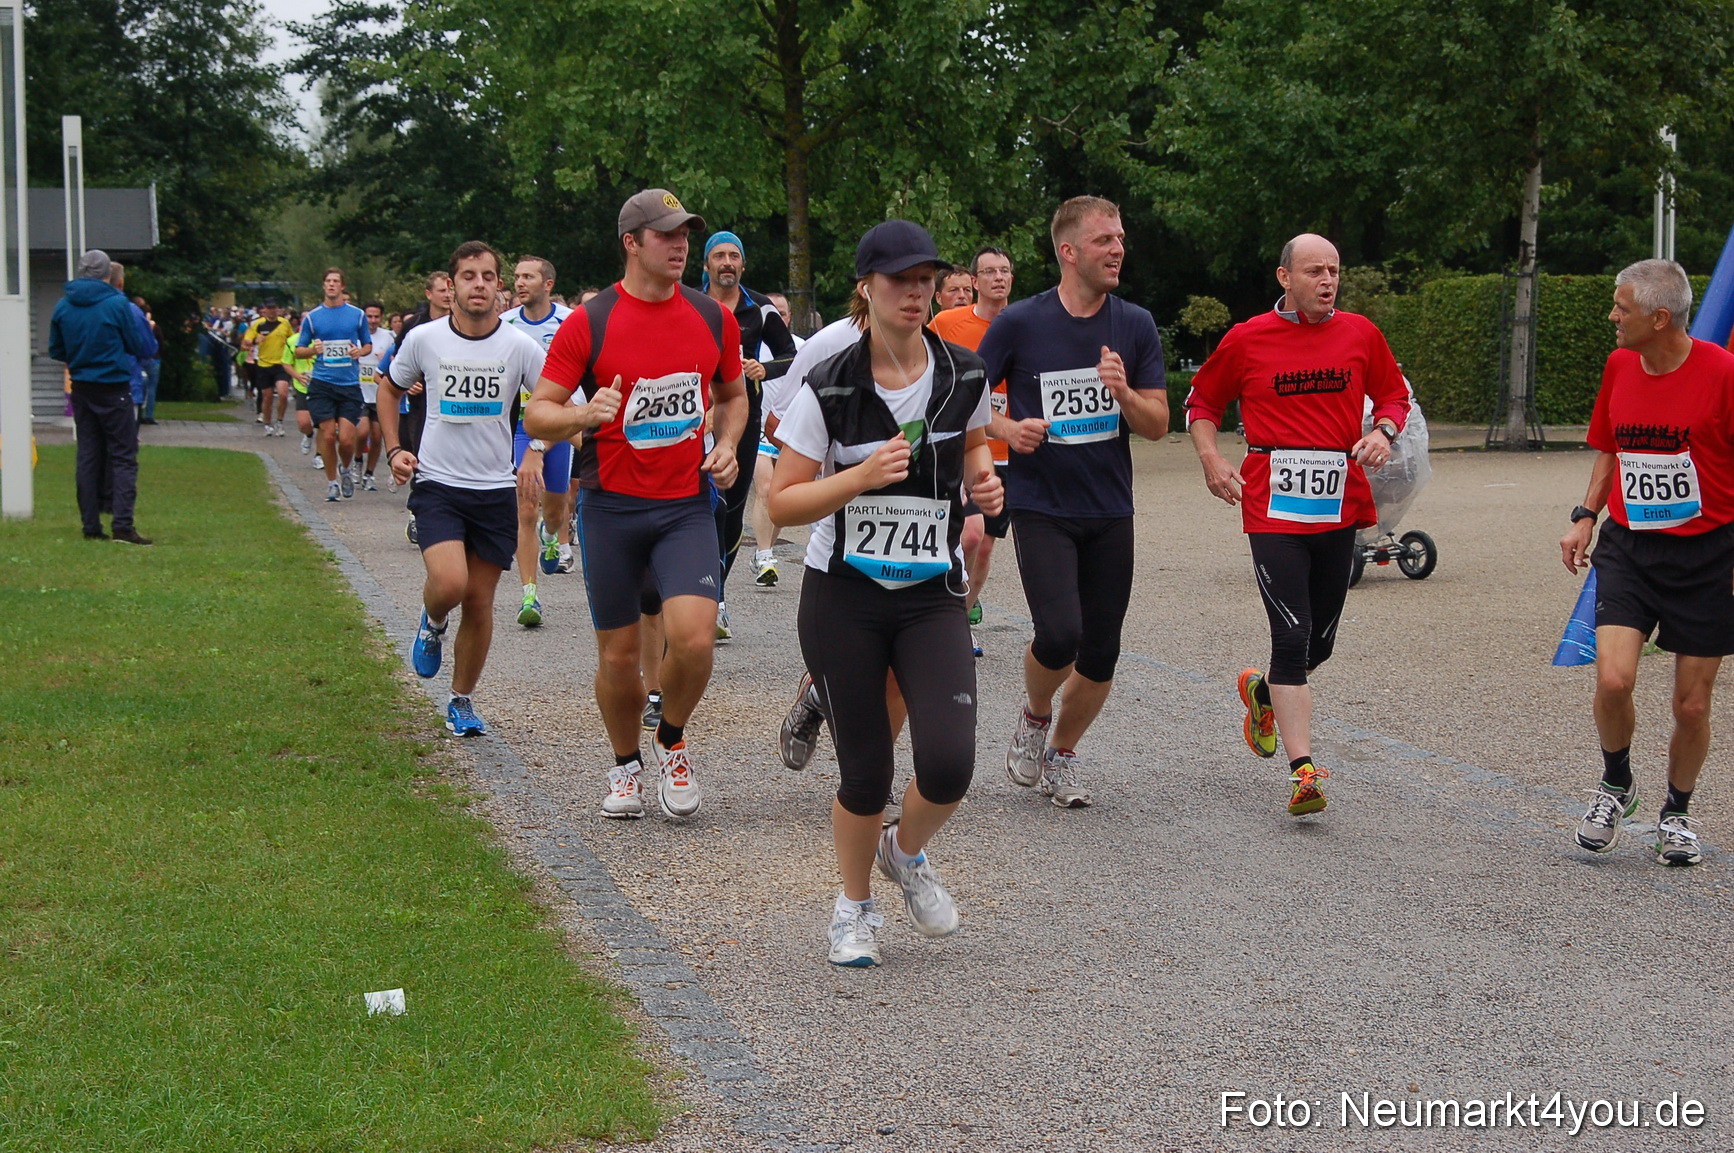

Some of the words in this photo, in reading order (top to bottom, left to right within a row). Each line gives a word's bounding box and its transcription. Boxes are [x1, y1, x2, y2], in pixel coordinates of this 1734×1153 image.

[326, 346, 349, 357] 2531
[440, 363, 461, 372] PARTL
[463, 365, 495, 373] Neumarkt
[445, 374, 500, 399] 2495
[657, 380, 690, 393] Neumarkt
[1043, 379, 1069, 388] PARTL
[1278, 383, 1297, 393] RUN
[1299, 380, 1316, 392] FOR
[633, 389, 696, 422] 2538
[1051, 386, 1114, 417] 2539
[451, 404, 490, 414] Christian
[650, 425, 678, 437] Holm
[1061, 421, 1109, 435] Alexander
[1272, 457, 1298, 465] PARTL
[1299, 458, 1335, 466] Neumarkt
[1621, 459, 1641, 469] PARTL
[1641, 460, 1679, 470] Neumarkt
[1278, 468, 1340, 496] 3150
[1625, 472, 1690, 501] 2656
[847, 505, 883, 515] PARTL
[885, 506, 931, 517] Neumarkt
[1643, 508, 1671, 519] Erich
[856, 520, 939, 557] 2744
[881, 564, 912, 578] Nina
